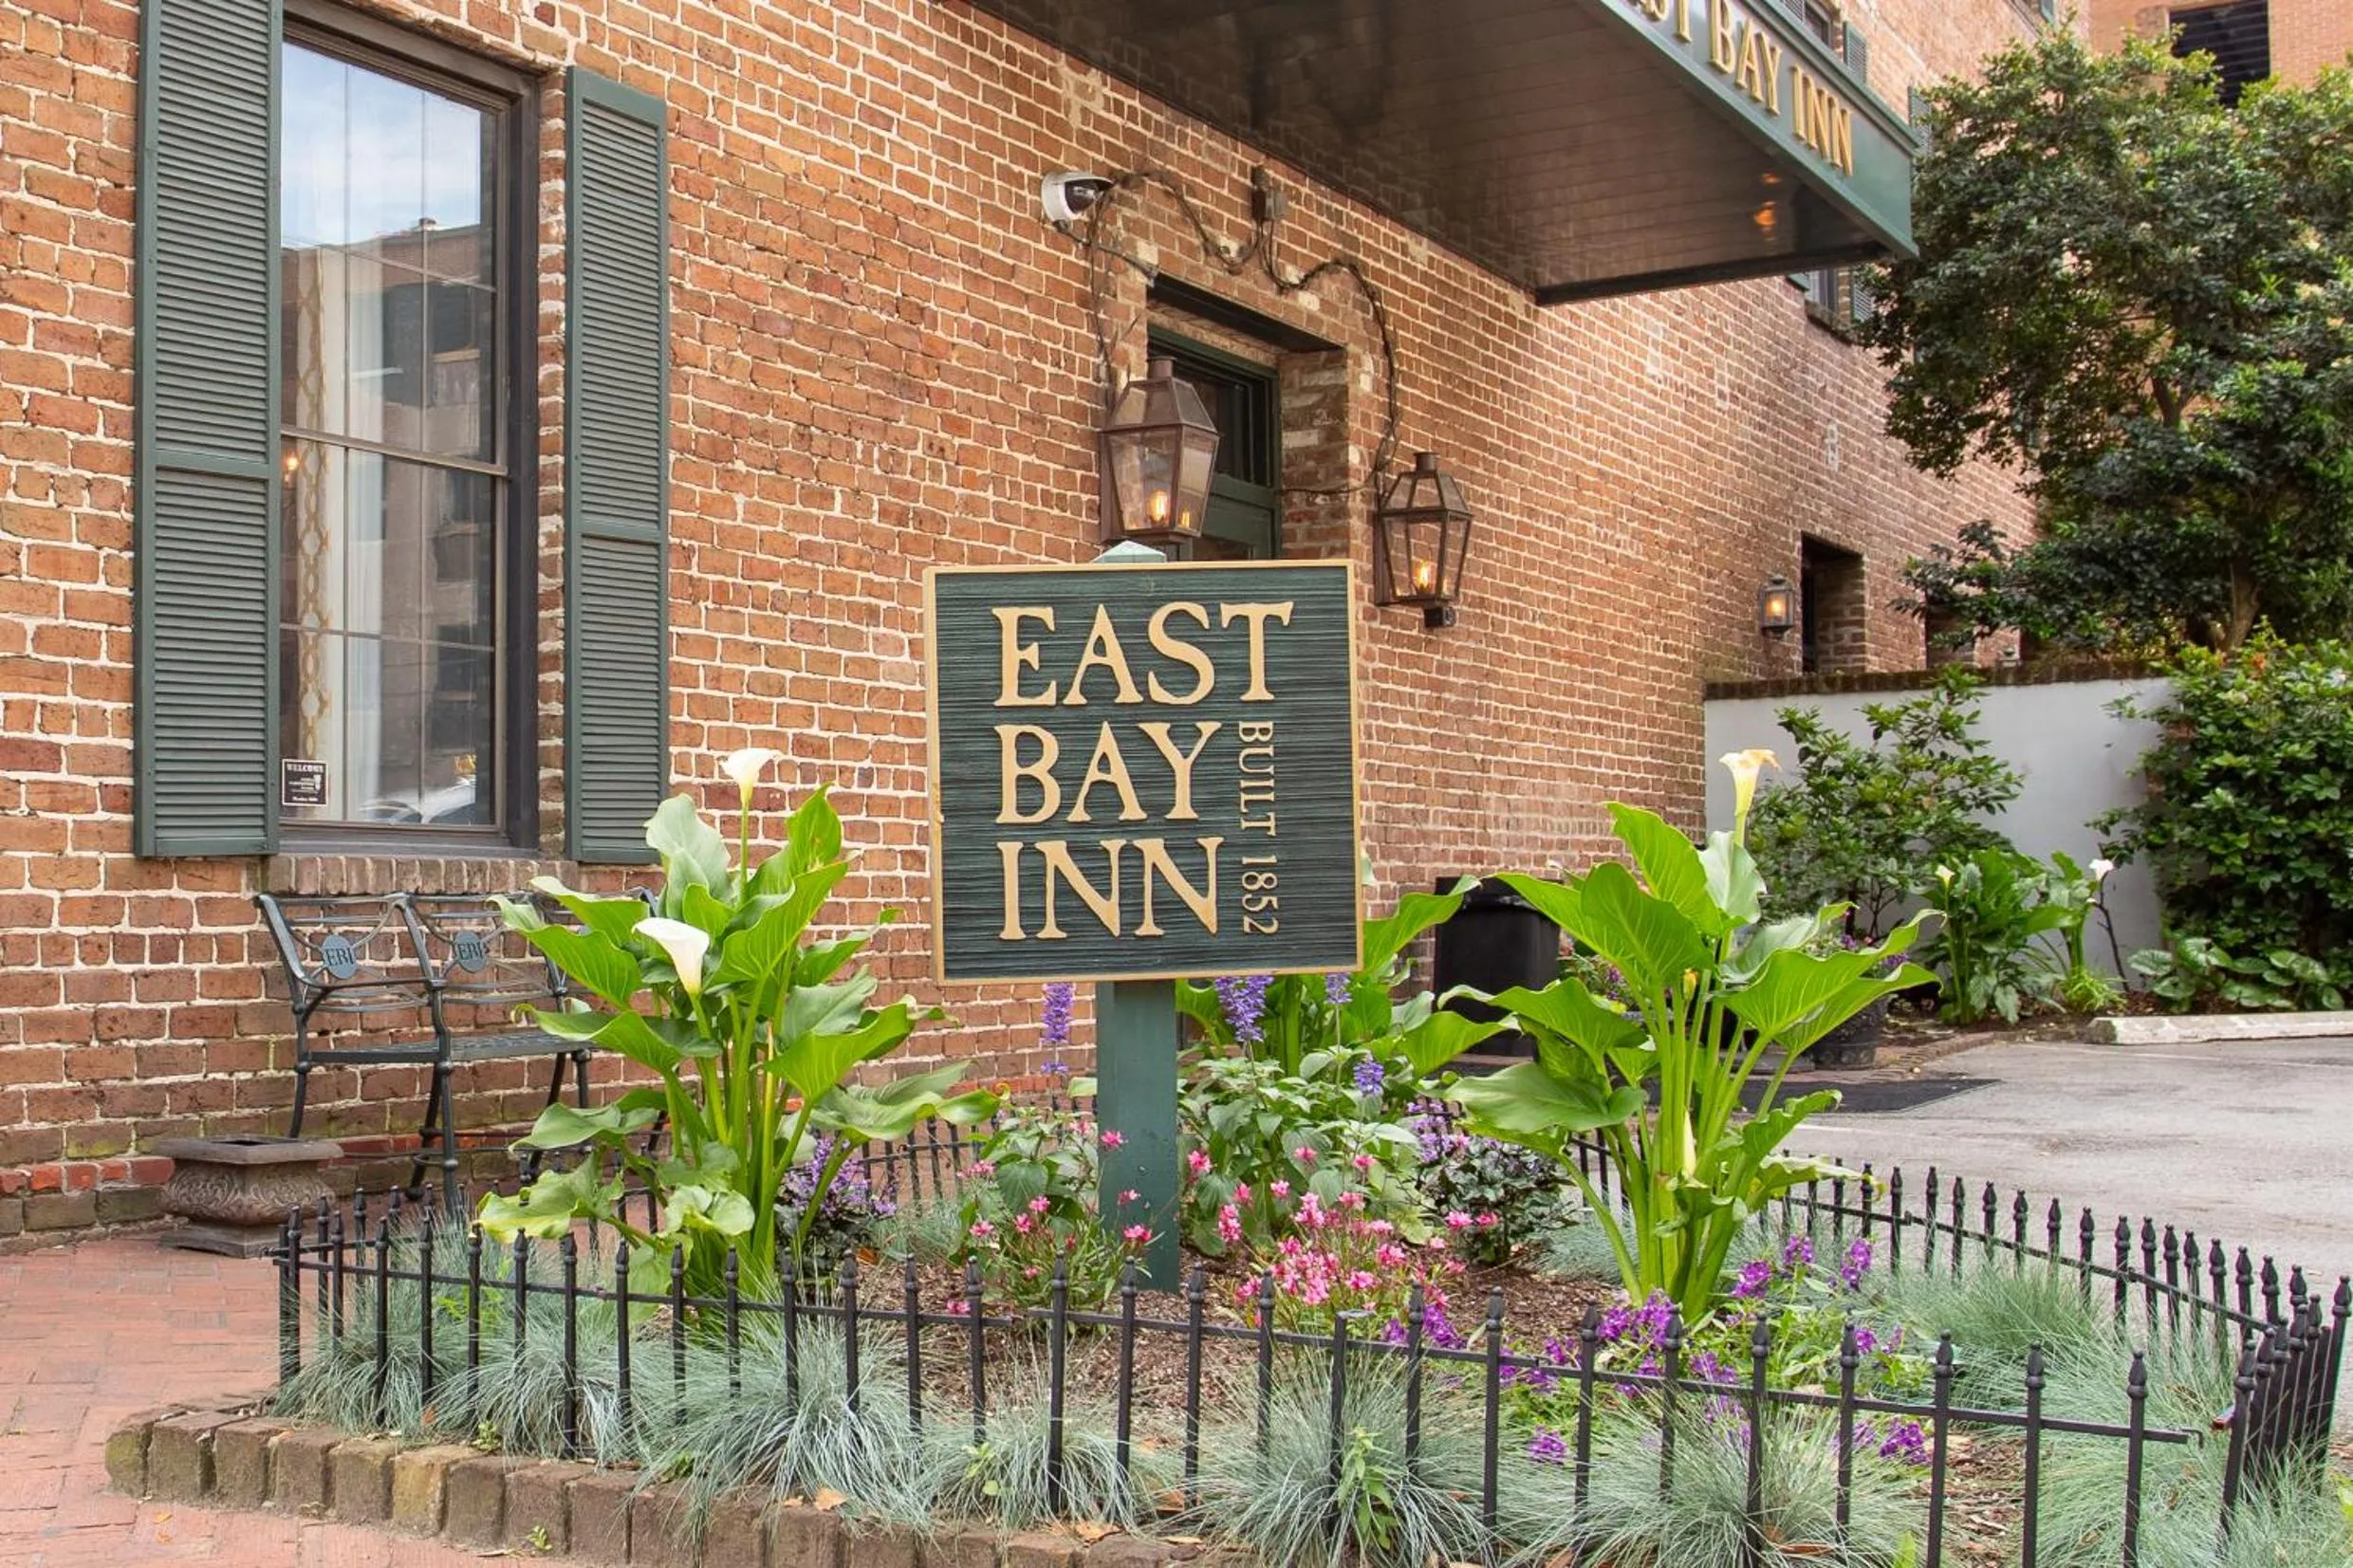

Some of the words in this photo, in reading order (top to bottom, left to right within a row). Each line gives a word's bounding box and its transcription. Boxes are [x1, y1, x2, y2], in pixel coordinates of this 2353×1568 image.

[1708, 0, 1783, 117] BAY
[1790, 64, 1854, 178] INN
[991, 600, 1295, 708] EAST
[993, 720, 1224, 824] BAY
[1238, 720, 1277, 838] BUILT
[995, 836, 1226, 941] INN
[1241, 854, 1280, 936] 1852
